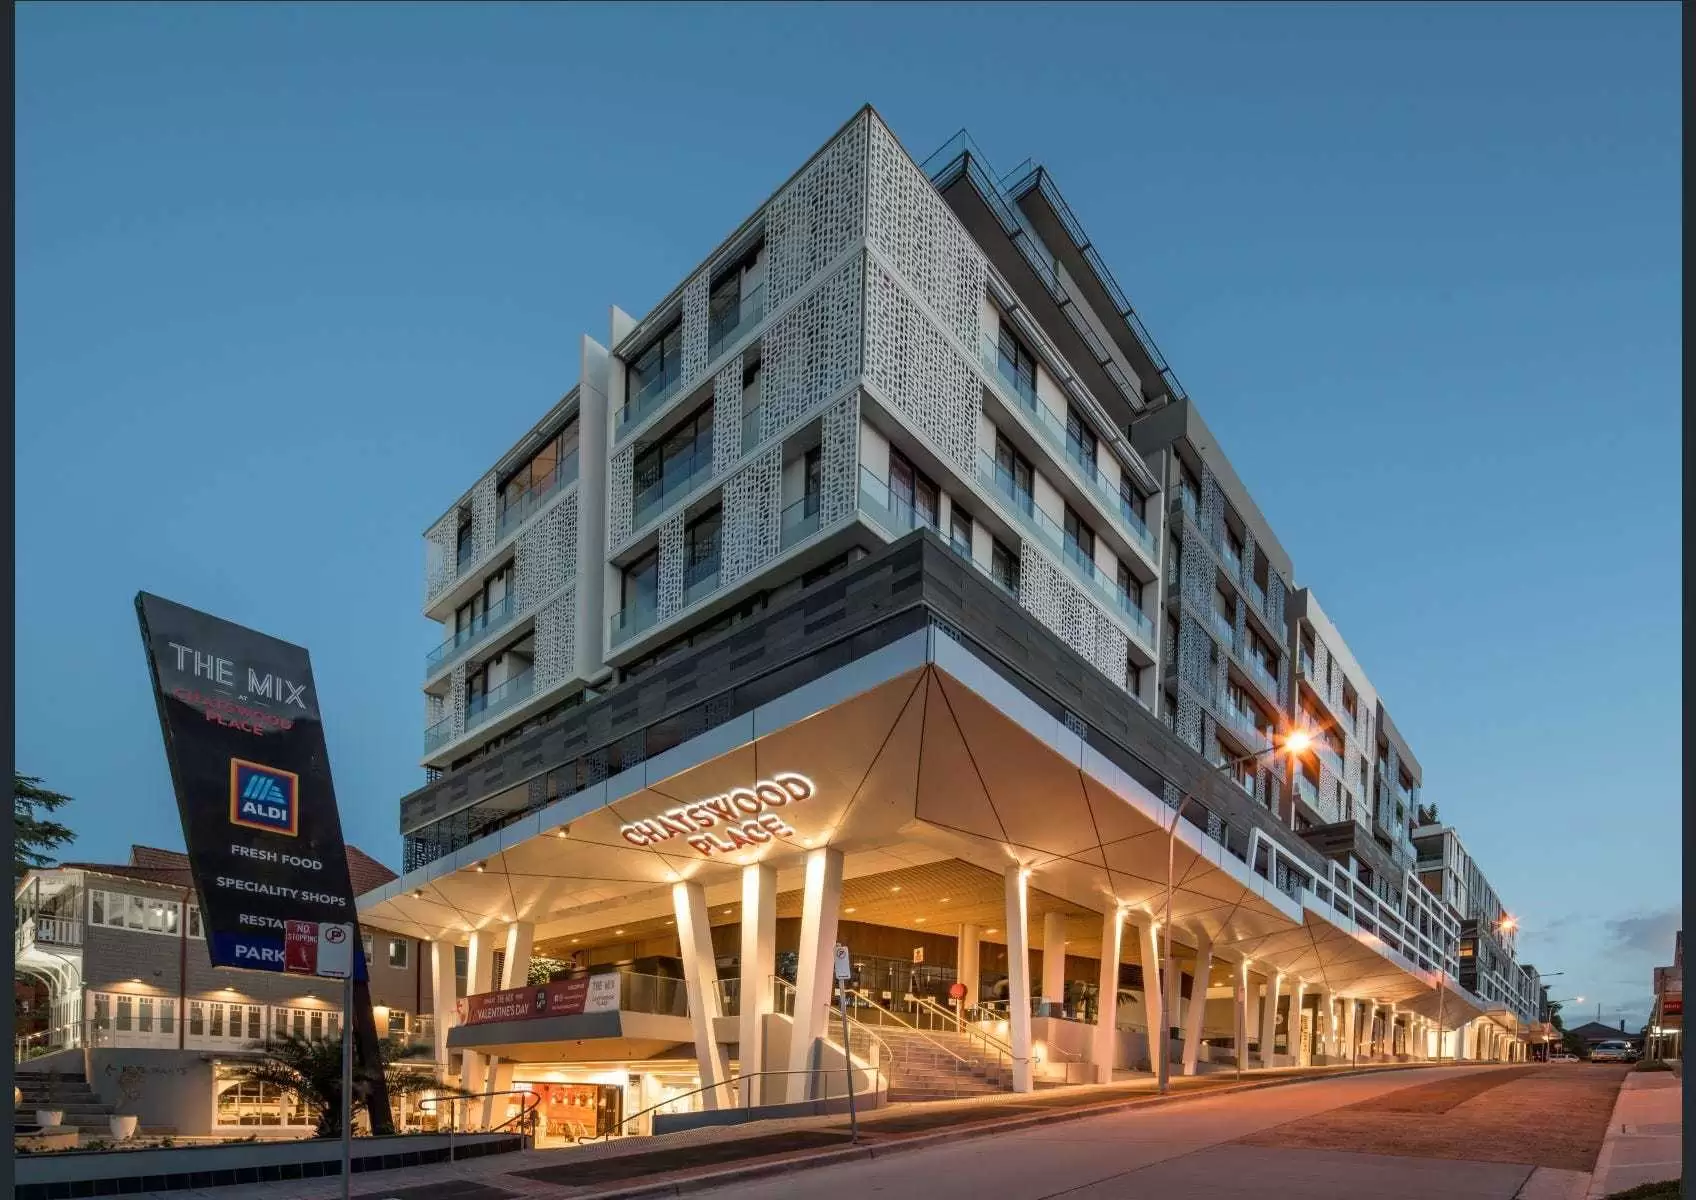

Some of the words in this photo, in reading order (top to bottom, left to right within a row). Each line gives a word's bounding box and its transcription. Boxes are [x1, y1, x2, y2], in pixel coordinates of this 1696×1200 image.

[168, 641, 234, 687] THE
[248, 667, 306, 709] MIX
[205, 710, 264, 736] PLACE
[242, 801, 288, 821] ALDI
[620, 772, 815, 846] CHATSWOOD
[688, 814, 794, 857] PLACE
[231, 844, 278, 863] FRESH
[281, 854, 323, 871] FOOD
[216, 876, 298, 899] SPECIALITY
[301, 890, 346, 907] SHOPS
[239, 913, 286, 930] RESTA
[296, 923, 310, 934] NO
[287, 933, 318, 944] STOPPING
[516, 1003, 529, 1015] DAY
